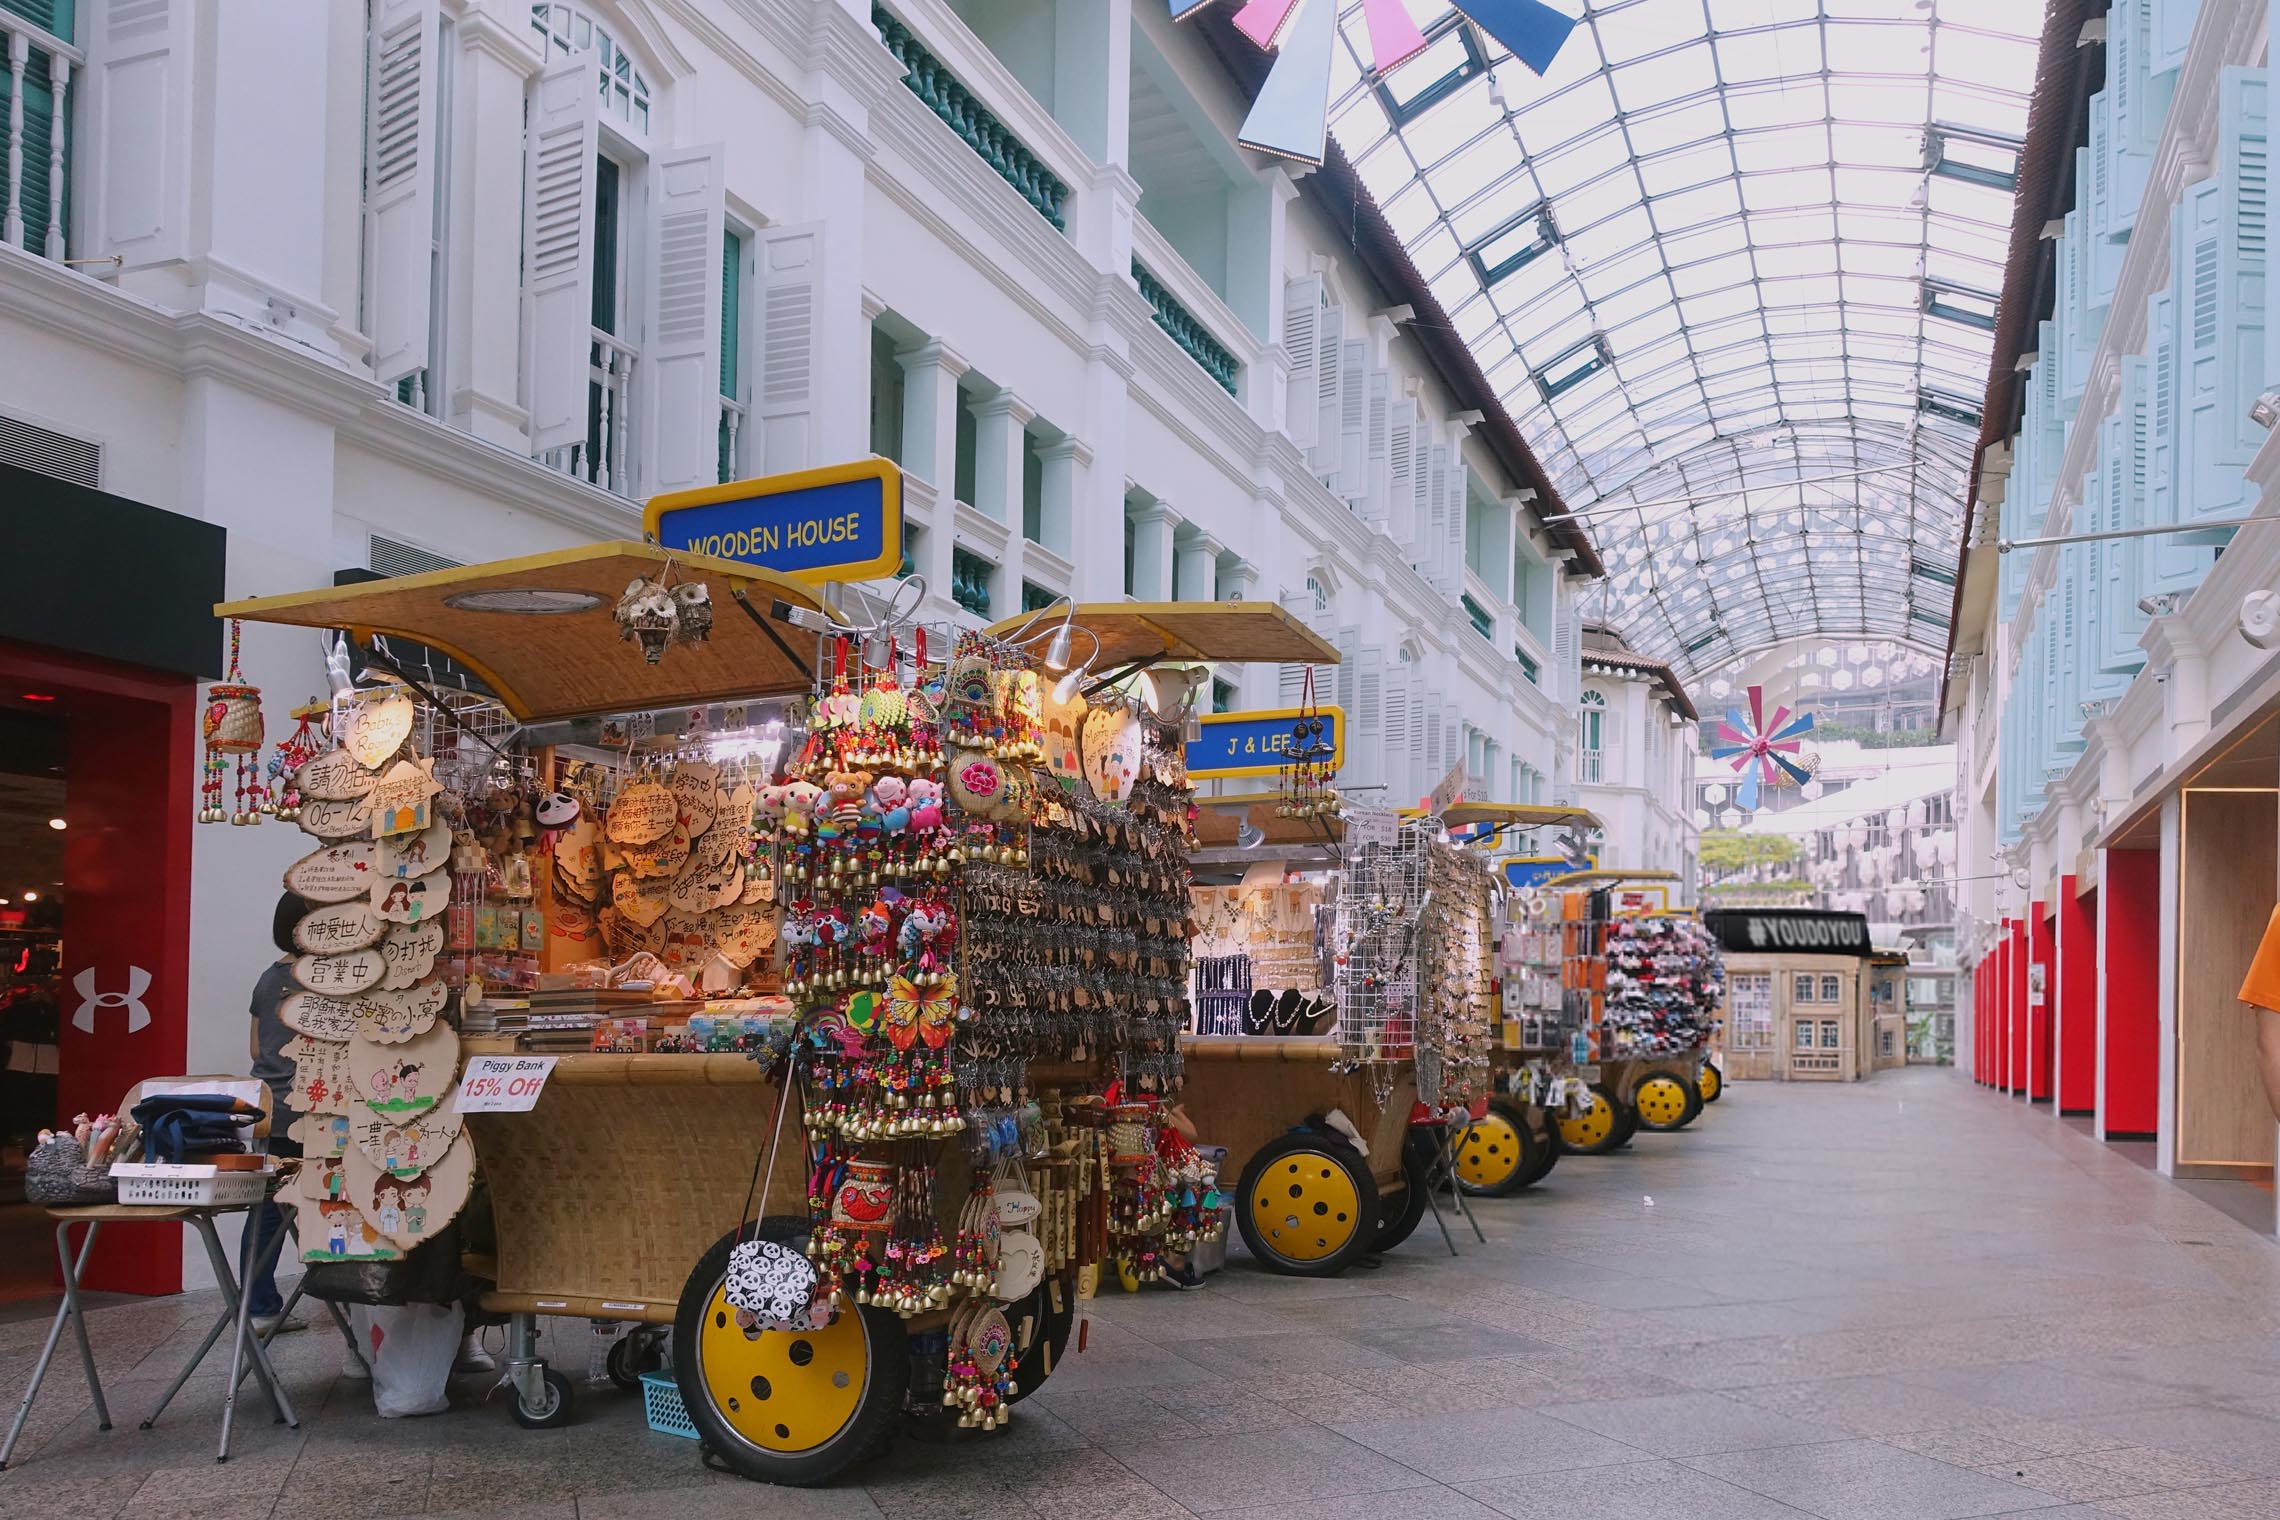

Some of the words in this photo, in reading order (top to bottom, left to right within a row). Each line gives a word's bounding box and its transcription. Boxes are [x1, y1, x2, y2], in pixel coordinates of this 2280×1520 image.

[688, 525, 779, 557] WOODEN
[787, 512, 859, 548] HOUSE
[1228, 738, 1239, 755] J
[1245, 737, 1255, 753] &
[1262, 734, 1291, 752] LEE
[1748, 917, 1862, 946] #YOUDOYOU
[482, 1061, 513, 1072] Piggy
[516, 1061, 545, 1070] Bank
[466, 1078, 502, 1096] 15%
[508, 1077, 543, 1096] Off
[1007, 1201, 1035, 1215] Happy
